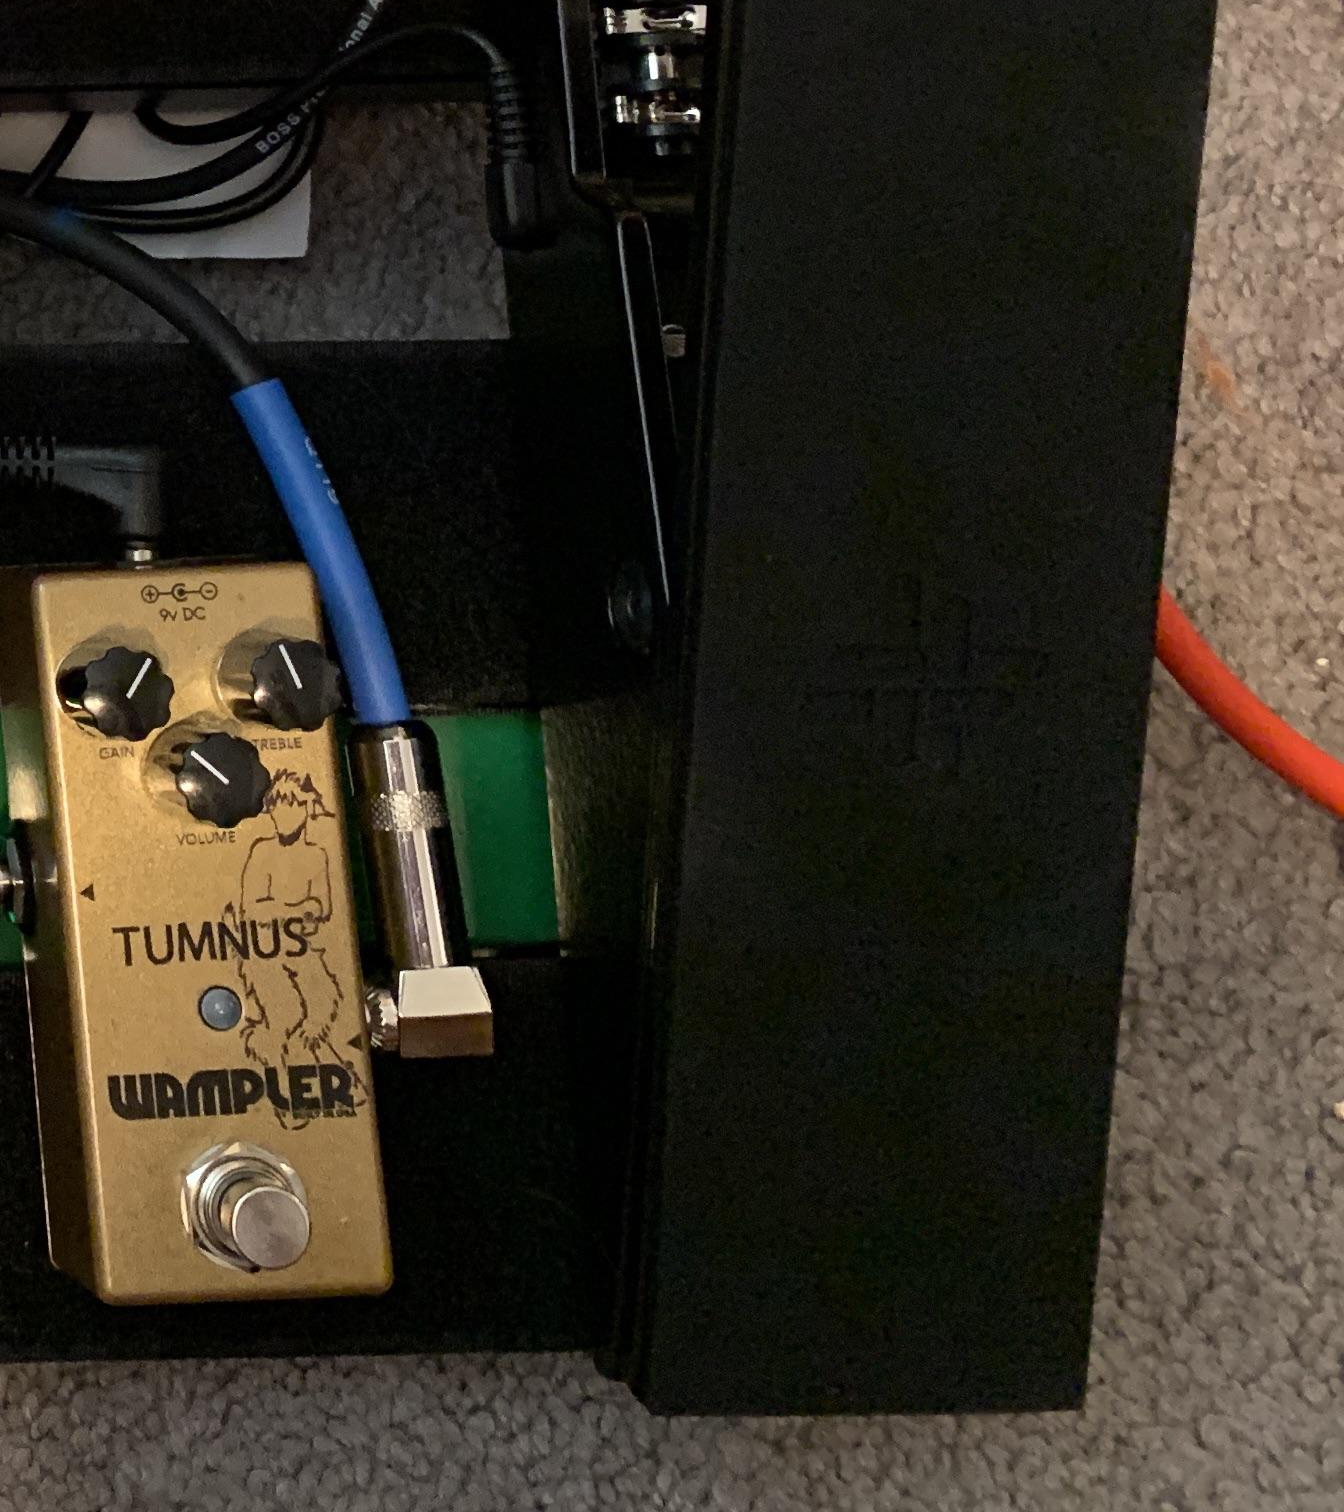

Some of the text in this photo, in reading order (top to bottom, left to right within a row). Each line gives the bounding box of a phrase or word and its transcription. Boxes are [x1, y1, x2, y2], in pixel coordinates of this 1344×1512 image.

[255, 112, 301, 154] BOSS
[182, 606, 206, 621] DC
[251, 737, 303, 751] TREBLE
[98, 746, 135, 760] GAIN
[176, 831, 237, 845] VOLUME
[112, 917, 309, 967] TUMNUS
[108, 1064, 355, 1121] WAMPLER
